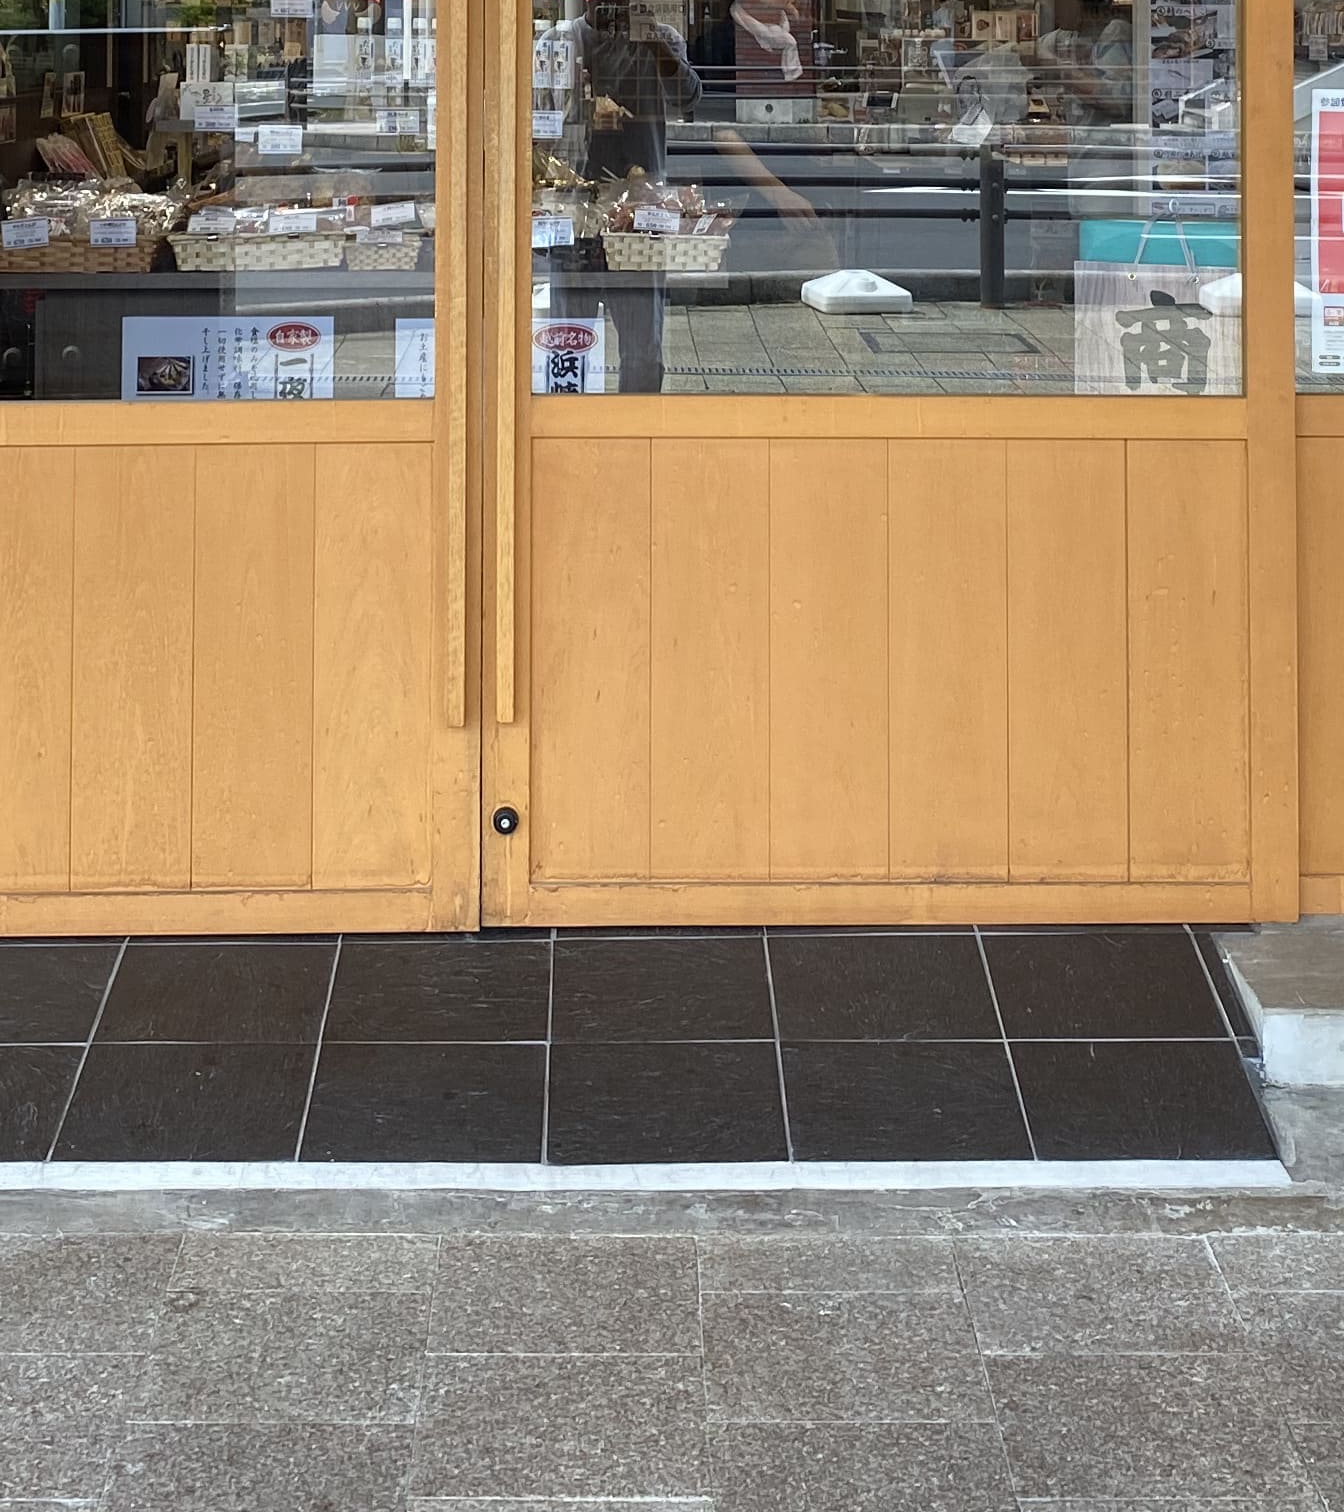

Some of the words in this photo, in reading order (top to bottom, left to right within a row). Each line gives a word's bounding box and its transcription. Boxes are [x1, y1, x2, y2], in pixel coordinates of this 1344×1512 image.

[276, 329, 312, 345] 自家製
[1115, 290, 1212, 394] 商
